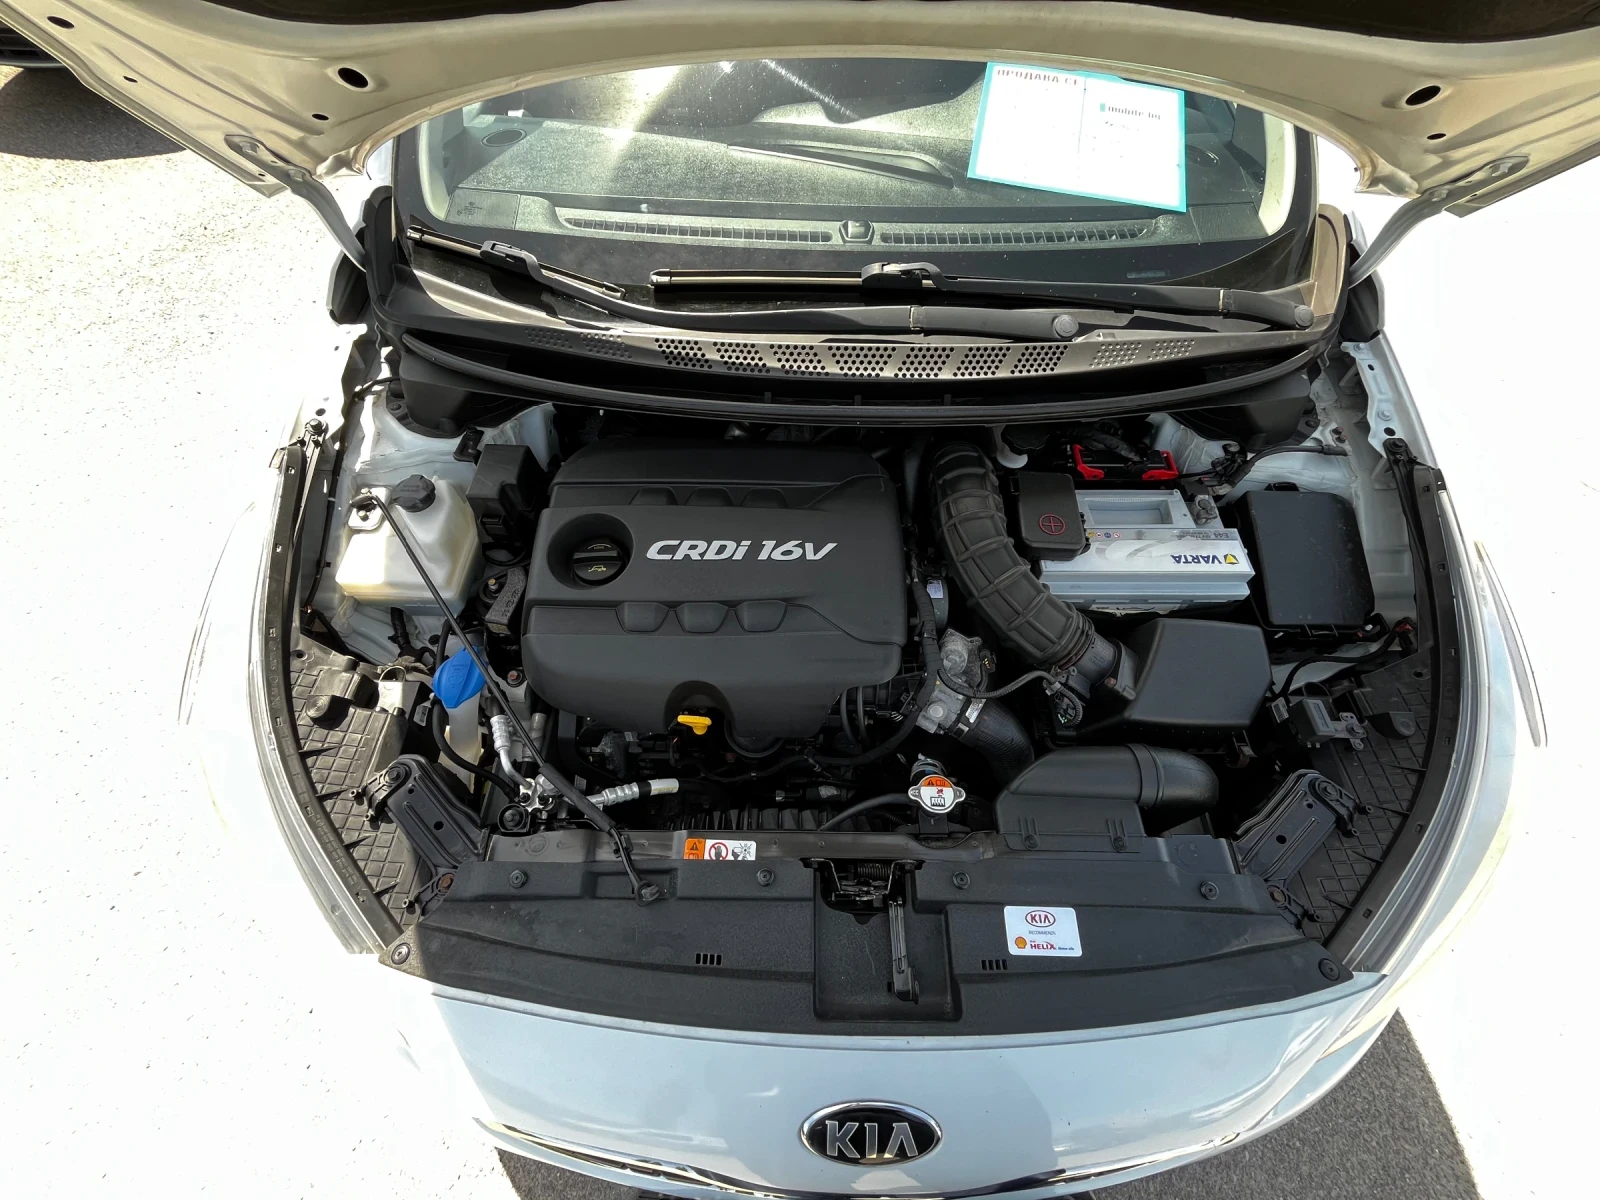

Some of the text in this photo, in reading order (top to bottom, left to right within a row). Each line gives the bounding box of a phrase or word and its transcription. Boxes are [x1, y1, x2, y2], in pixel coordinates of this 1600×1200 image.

[646, 540, 752, 560] CRDi
[1170, 554, 1222, 565] VARTA
[1030, 913, 1052, 924] KIA
[1030, 942, 1056, 951] HELIX
[825, 1120, 919, 1159] KIA
